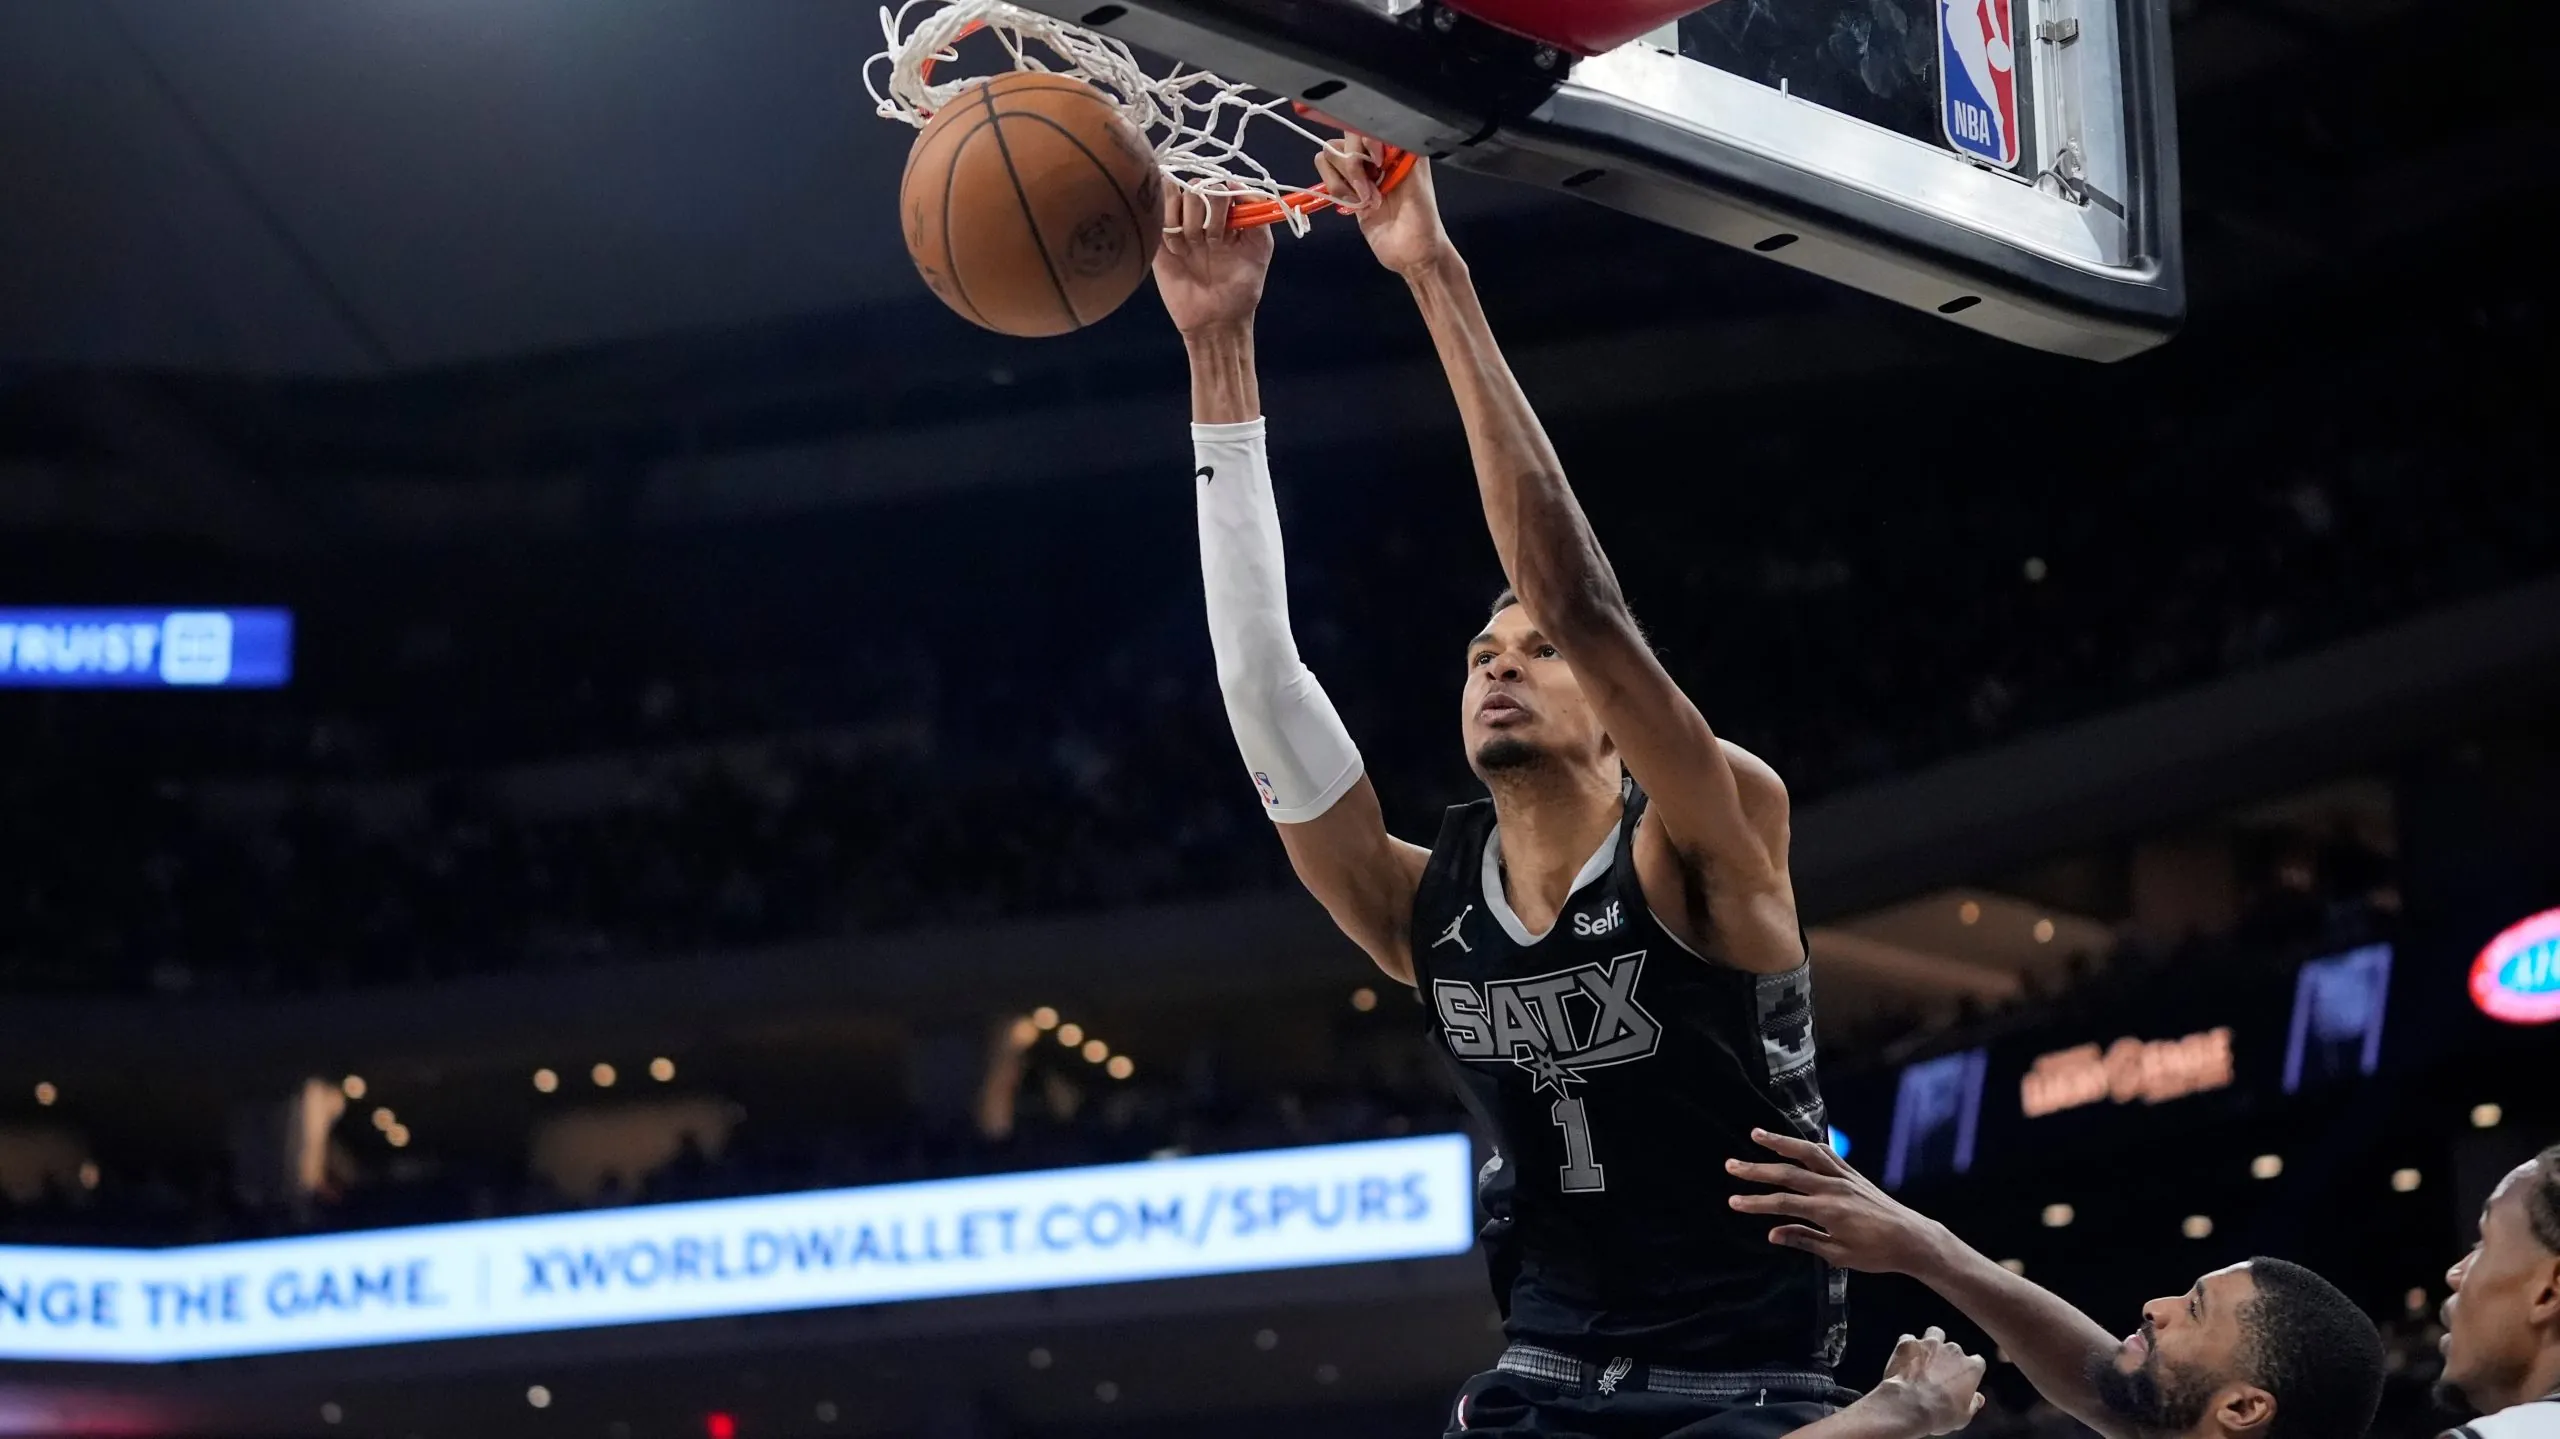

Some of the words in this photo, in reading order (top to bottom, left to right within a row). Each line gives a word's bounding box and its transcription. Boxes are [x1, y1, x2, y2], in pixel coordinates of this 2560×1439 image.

[1953, 99, 1991, 147] NBA
[0, 622, 161, 673] TRUIST
[1433, 950, 1662, 1070] SATX
[1551, 1097, 1605, 1192] 1
[140, 1273, 247, 1328] THE
[521, 1170, 1432, 1297] XWORLDWALLET.COM/SPURS
